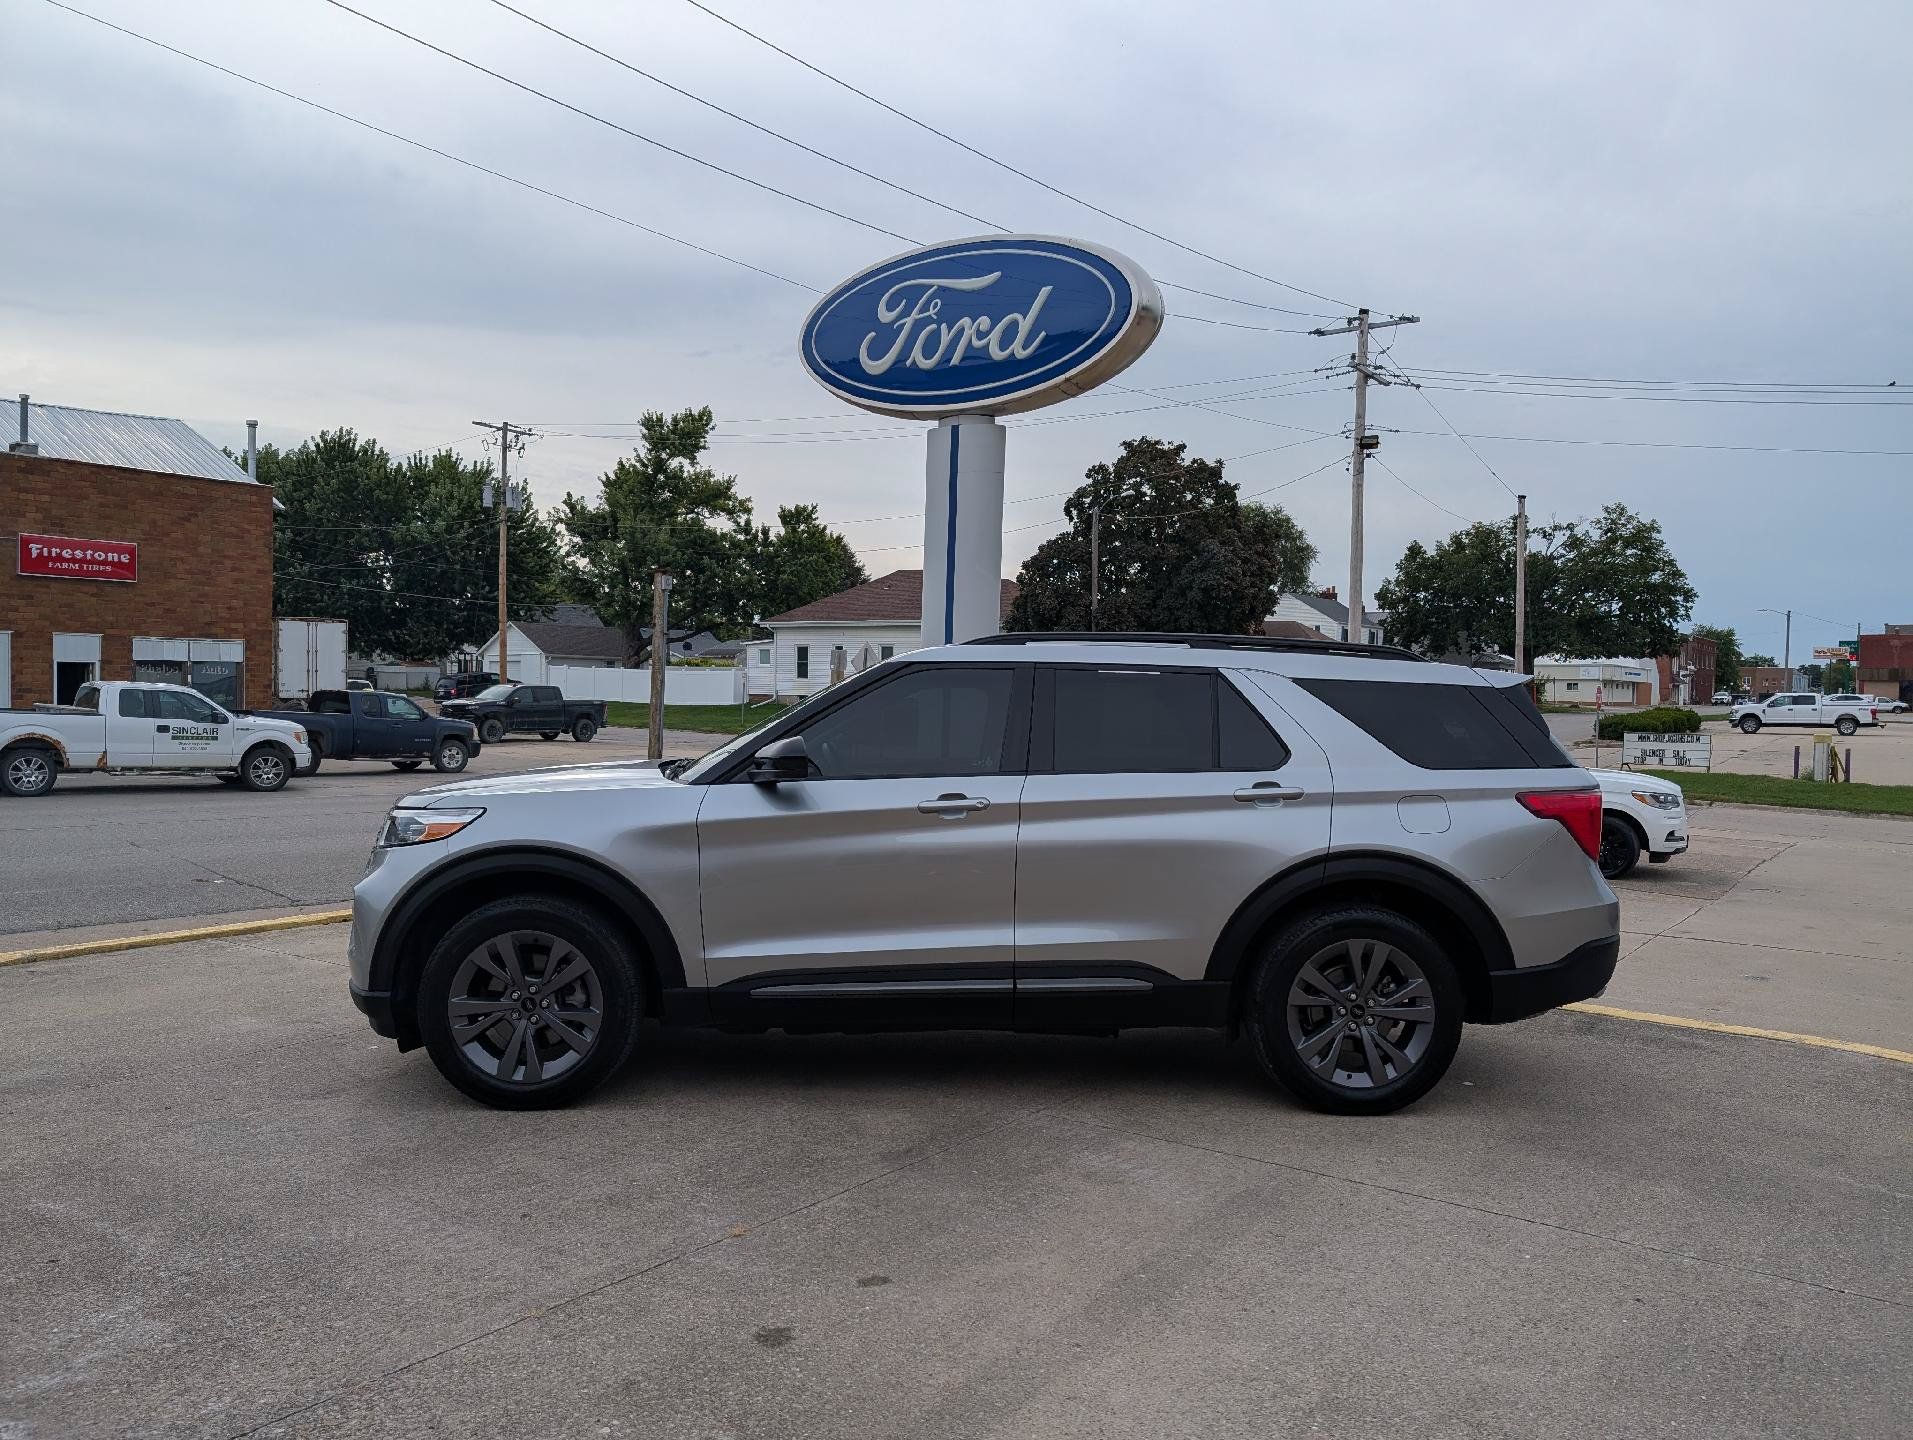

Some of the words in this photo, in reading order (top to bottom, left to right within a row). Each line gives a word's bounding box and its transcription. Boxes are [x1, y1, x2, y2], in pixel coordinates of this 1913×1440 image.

[859, 271, 1053, 375] Ford
[28, 543, 131, 562] Firestone
[48, 561, 80, 570] FARM
[171, 726, 219, 735] SINCLAIR
[1633, 756, 1647, 765] STOP
[1675, 758, 1692, 766] TODAY
